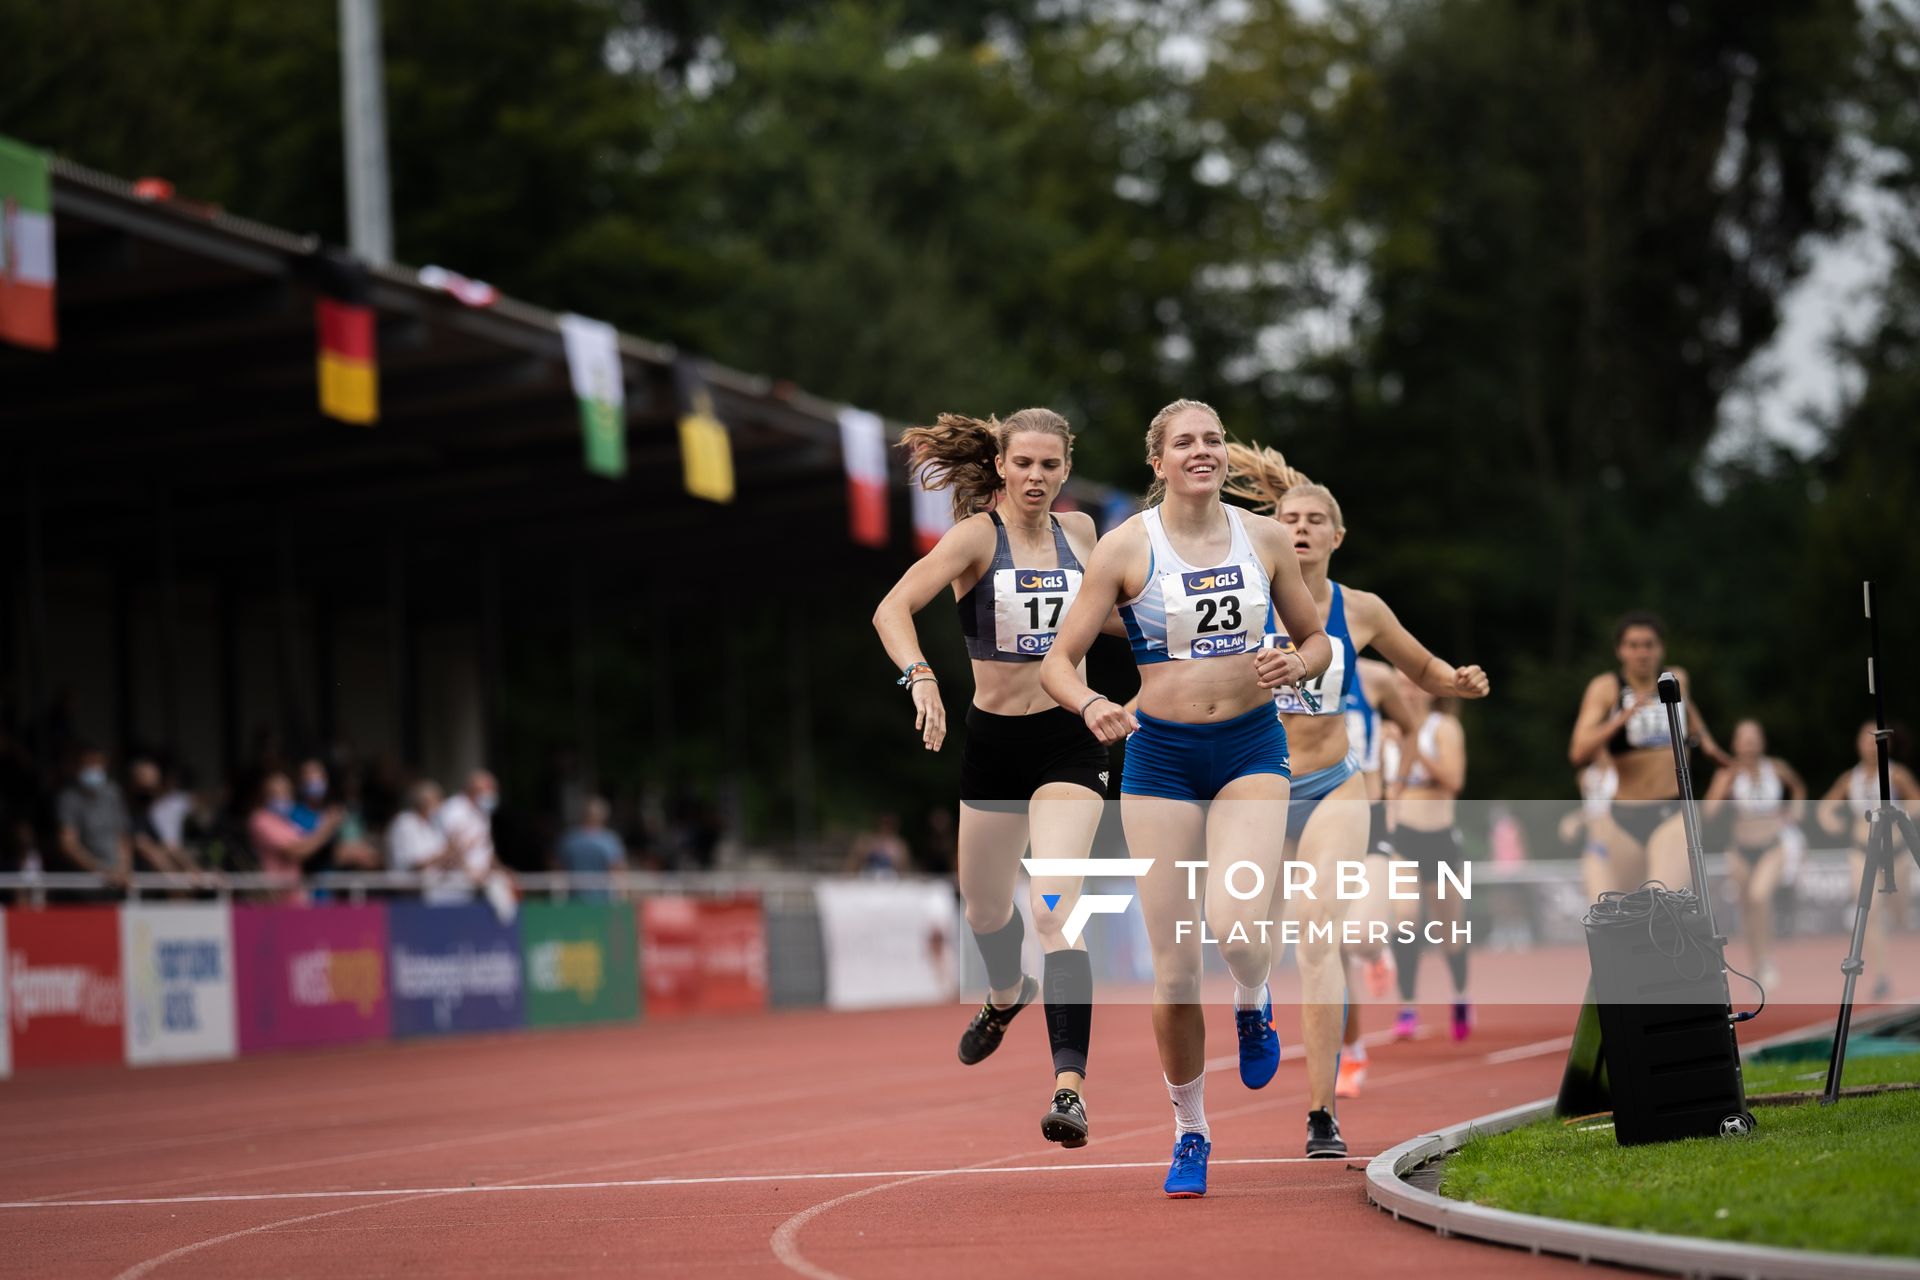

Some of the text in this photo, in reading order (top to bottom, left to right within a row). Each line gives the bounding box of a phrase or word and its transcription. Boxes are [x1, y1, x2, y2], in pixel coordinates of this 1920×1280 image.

[1042, 576, 1063, 588] GLS
[1215, 573, 1239, 587] GLS
[1024, 597, 1064, 630] 17
[1196, 595, 1242, 633] 23
[1040, 635, 1056, 646] PLA
[1216, 635, 1245, 649] PLAN
